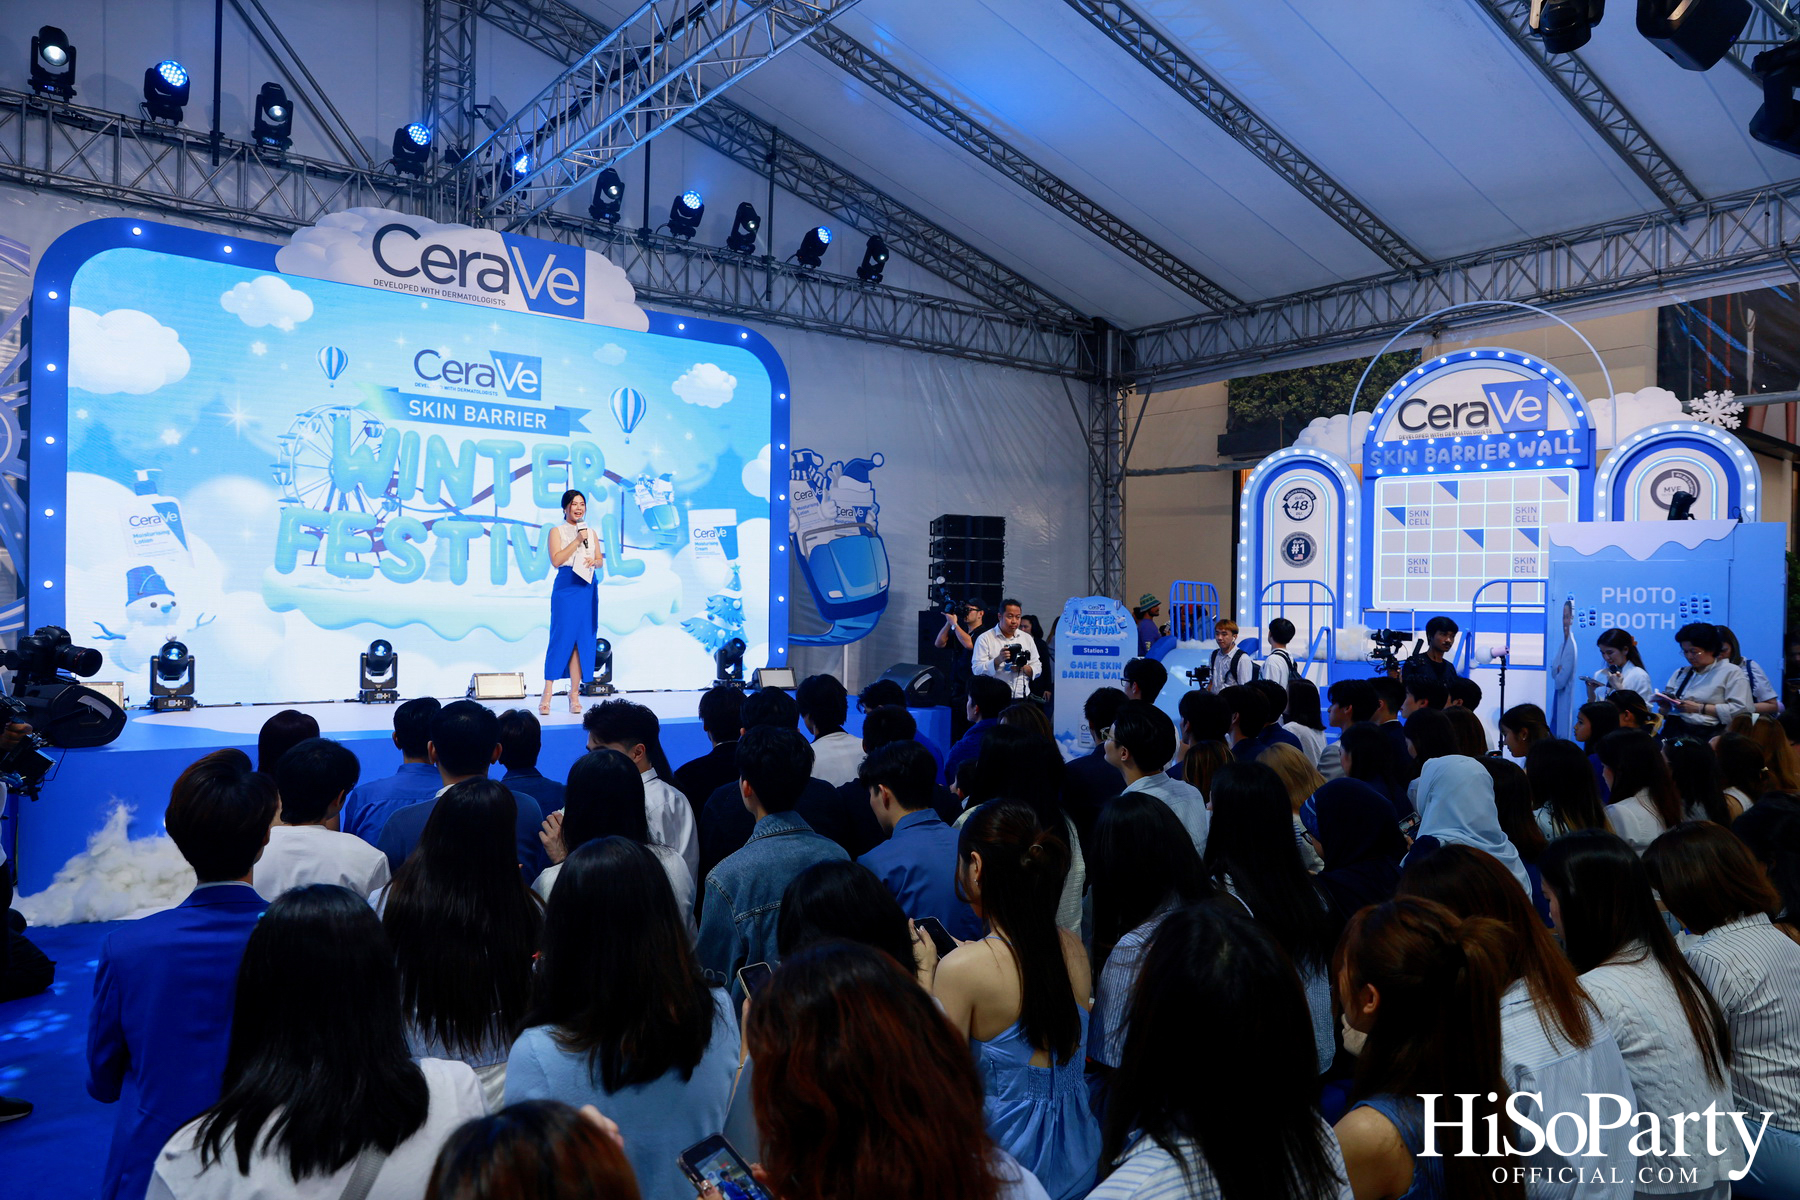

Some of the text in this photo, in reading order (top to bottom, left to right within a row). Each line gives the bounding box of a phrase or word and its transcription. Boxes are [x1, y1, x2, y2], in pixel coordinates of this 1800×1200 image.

[372, 223, 580, 306] CeraVe
[373, 278, 506, 307] DEVELOPED WITH DERMATOLOGISTS
[414, 349, 538, 393] CeraVe
[457, 387, 499, 397] DERMATOLOGISTS
[408, 400, 547, 429] SKIN BARRIER
[1398, 389, 1542, 431] CeraVe
[1445, 429, 1492, 437] DERMATOLOGISTS
[1370, 437, 1581, 467] SKIN BARRIER WALL
[332, 416, 608, 509] WINTER
[794, 486, 823, 501] CeraVe
[1291, 500, 1309, 510] 48
[1515, 506, 1538, 514] SKIN
[129, 511, 179, 527] CeraVe
[1408, 510, 1430, 518] SKIN
[1515, 514, 1538, 523] CELL
[1408, 518, 1430, 526] CELL
[693, 528, 727, 539] CeraVe
[274, 507, 645, 586] FESTIVL
[1291, 544, 1305, 554] #1
[1407, 558, 1428, 566] SKIN
[1514, 557, 1537, 565] SKIN
[1407, 566, 1429, 574] CELL
[1514, 565, 1537, 574] CELL
[1601, 587, 1676, 604] PHOTO
[1079, 615, 1116, 626] WINTER
[1601, 612, 1676, 630] BOOTH
[1072, 624, 1121, 635] FESTIVAL
[1070, 661, 1122, 670] GAME SKIN
[1062, 670, 1123, 680] BARRIER WAL
